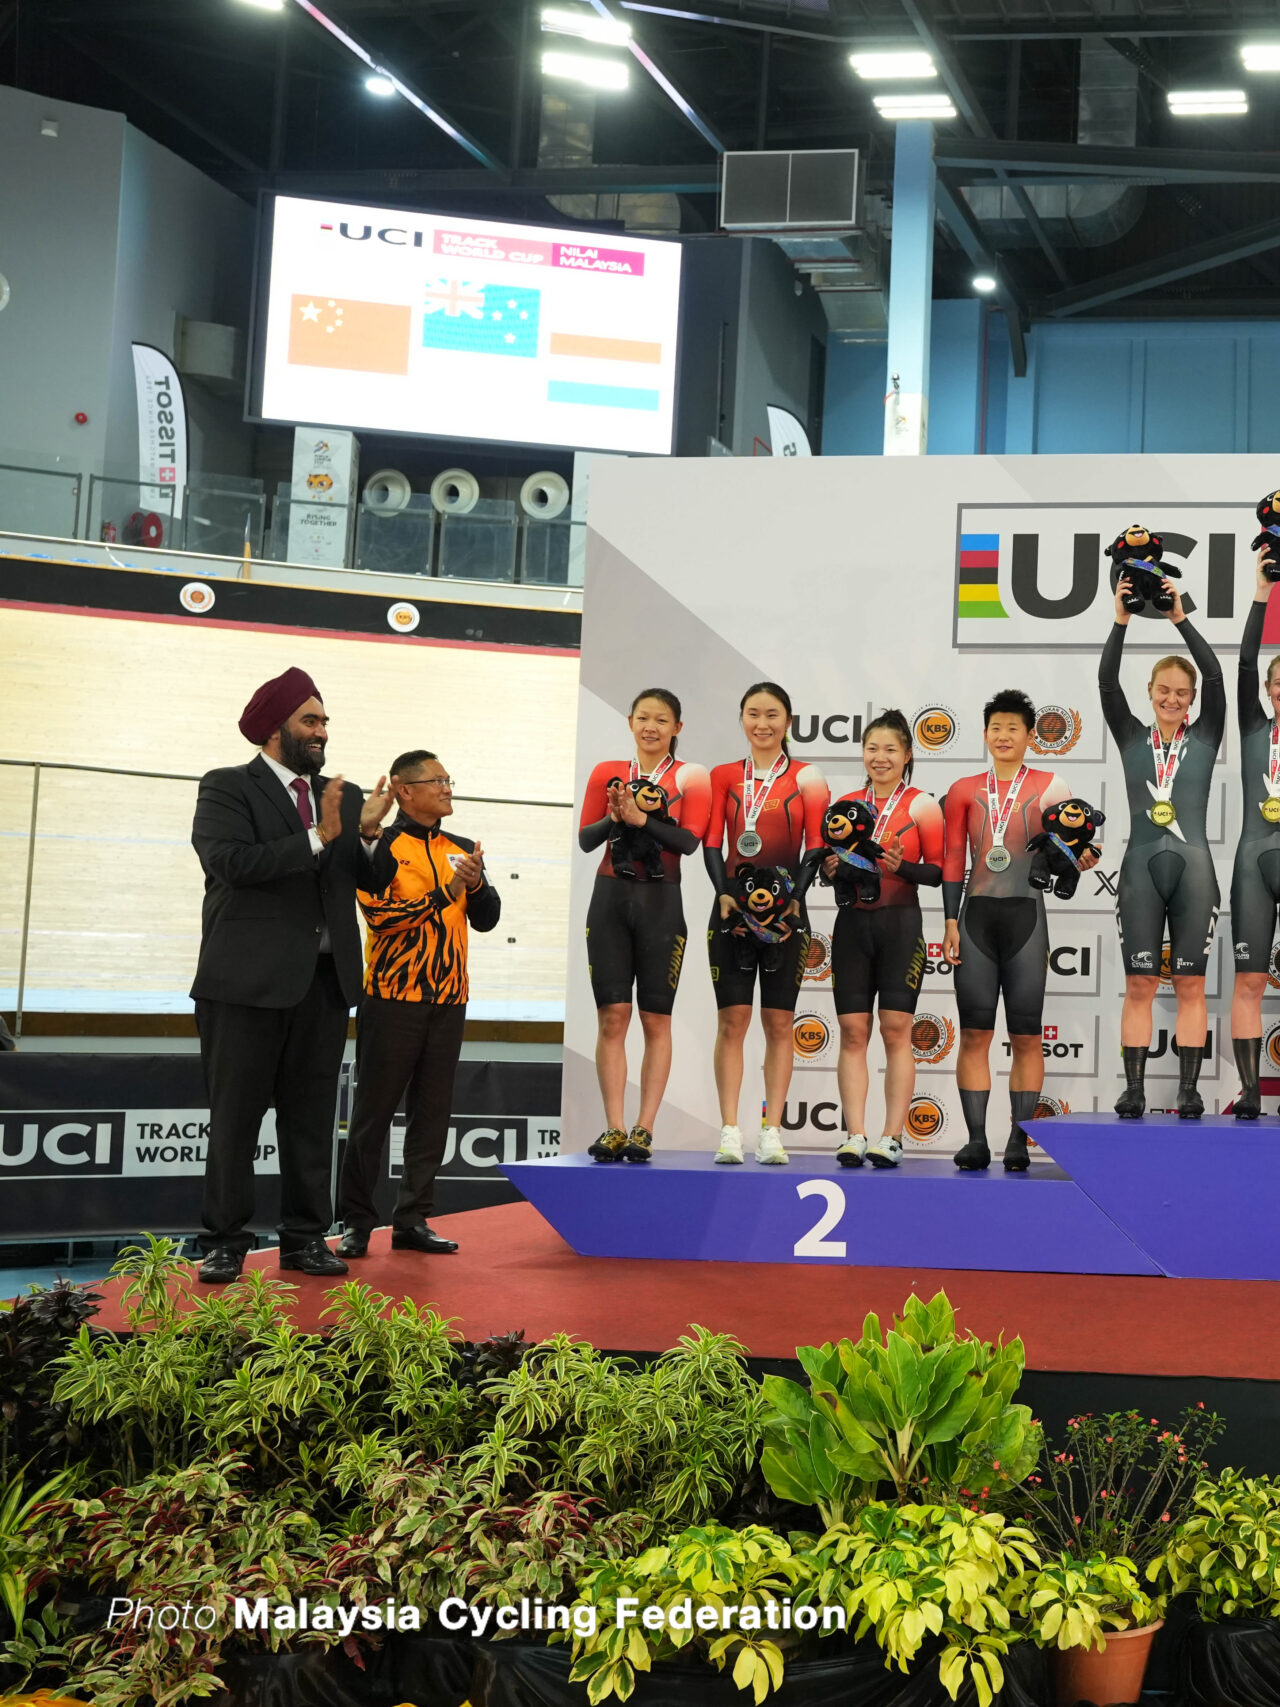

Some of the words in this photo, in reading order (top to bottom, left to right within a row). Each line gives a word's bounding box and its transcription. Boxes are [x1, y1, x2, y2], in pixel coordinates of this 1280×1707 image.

[339, 222, 423, 247] UCI
[441, 233, 498, 249] TRACK
[441, 244, 506, 261] WORLD
[509, 251, 545, 265] CUP
[560, 246, 598, 259] NILAI
[560, 256, 632, 273] MALAYSIA
[791, 714, 863, 744] UCI
[926, 724, 948, 734] KBS
[668, 934, 687, 990] CHINA
[1050, 946, 1091, 976] CI
[800, 1031, 822, 1041] KBS
[914, 1113, 936, 1123] KBS
[136, 1145, 208, 1163] WORL
[794, 1179, 847, 1257] 2
